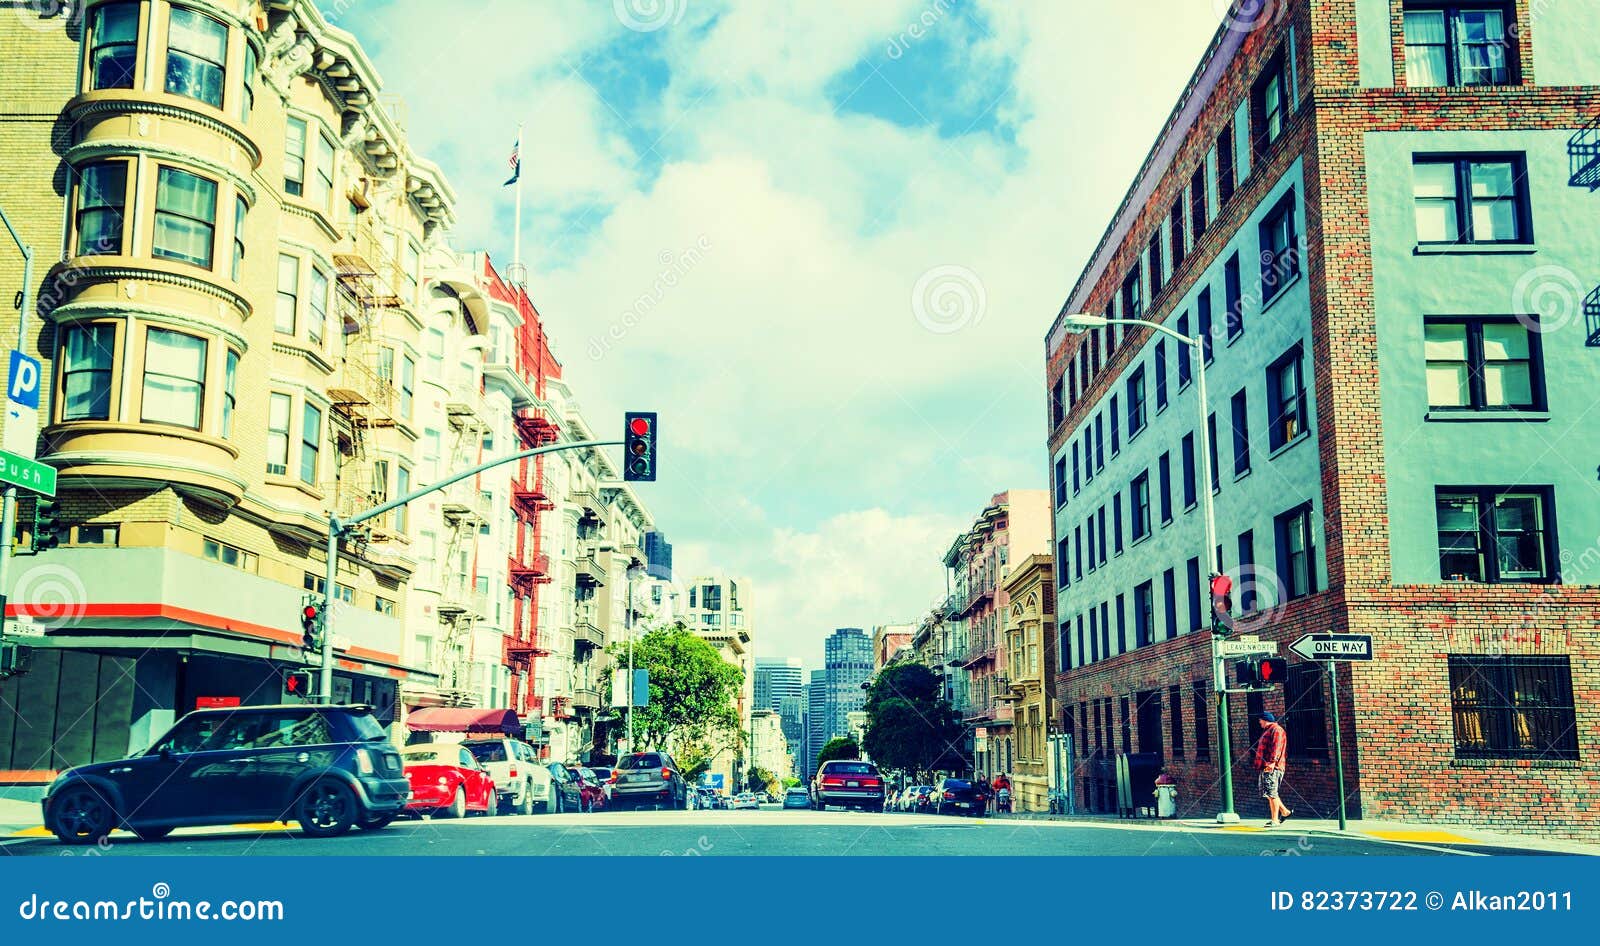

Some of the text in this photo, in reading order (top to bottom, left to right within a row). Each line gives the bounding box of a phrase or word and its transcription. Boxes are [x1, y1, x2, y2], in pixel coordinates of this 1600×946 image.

[0, 457, 41, 484] Bush
[1226, 643, 1275, 651] LEAVENWORTH
[1315, 642, 1364, 652] ONE WAY
